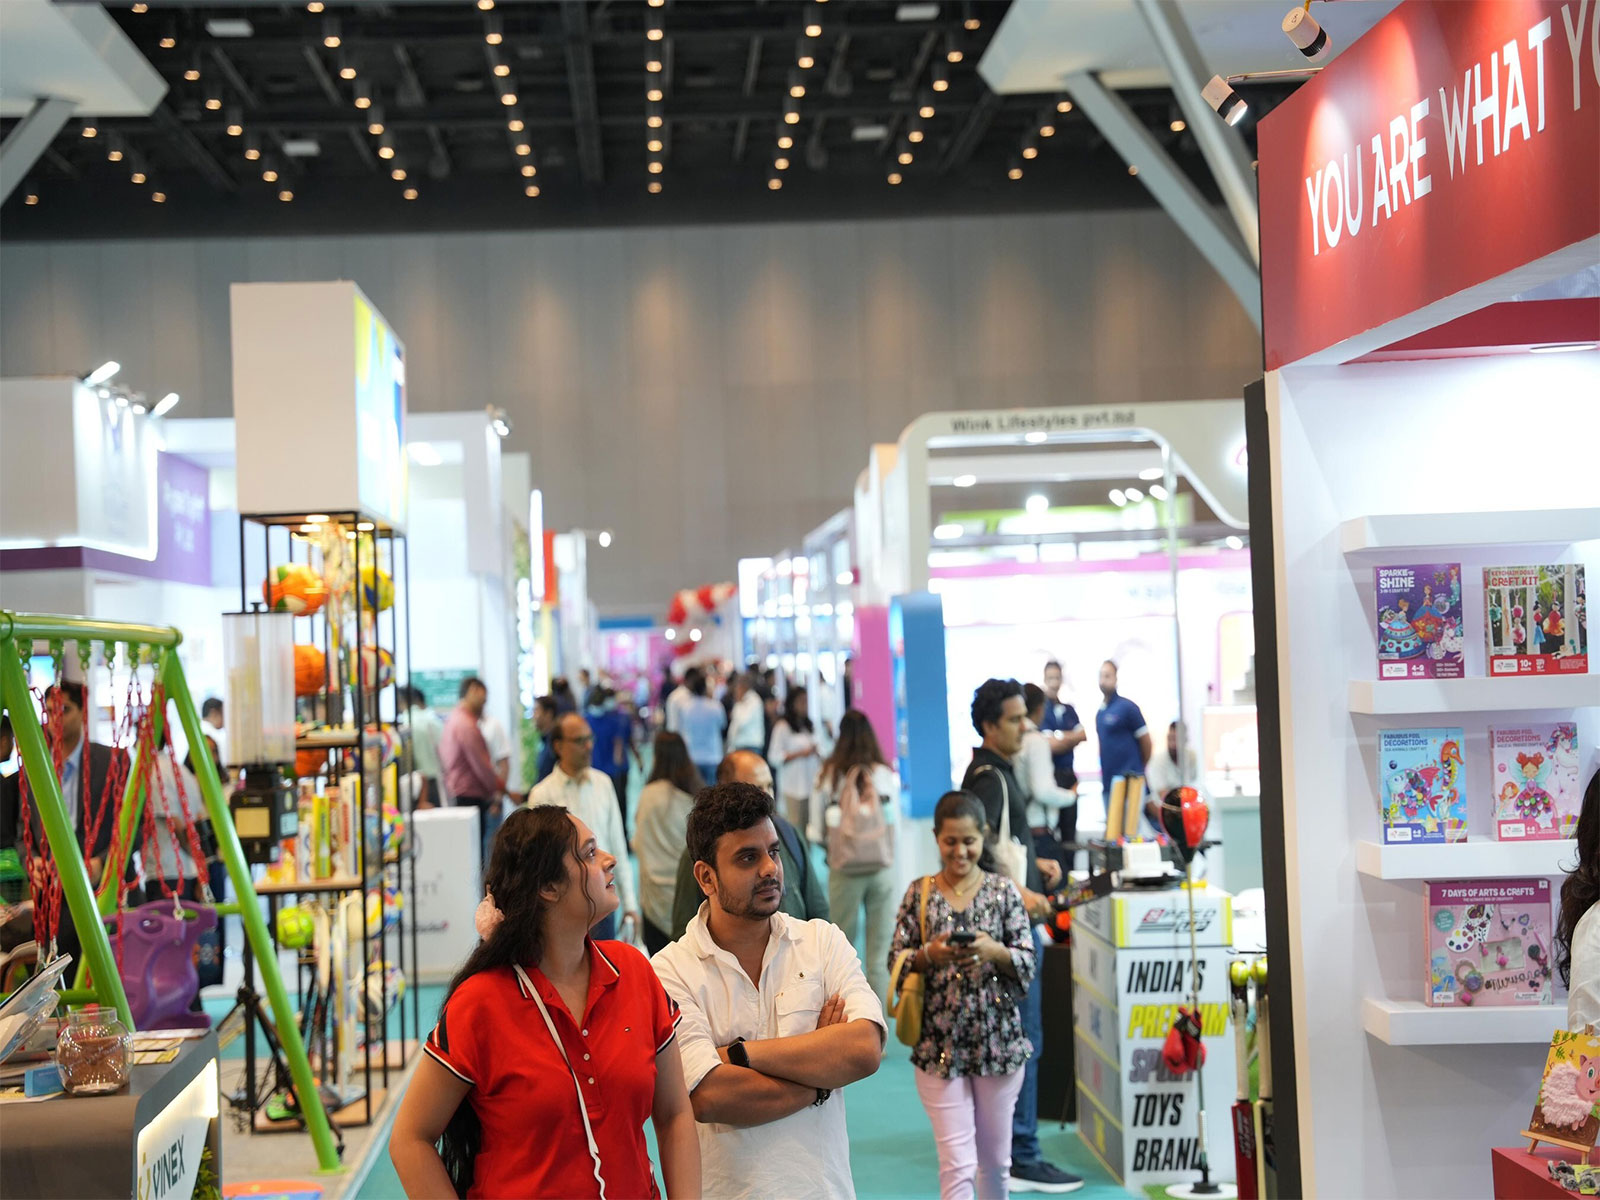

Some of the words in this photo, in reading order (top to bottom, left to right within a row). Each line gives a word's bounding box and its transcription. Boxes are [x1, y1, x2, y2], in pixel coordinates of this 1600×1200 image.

[1305, 144, 1363, 256] YOU
[1371, 97, 1432, 228] ARE
[1439, 16, 1551, 181] WHAT
[951, 415, 992, 433] Wink
[998, 413, 1077, 433] Lifestyles
[1380, 577, 1415, 589] SHINE
[1491, 577, 1520, 587] CRAFT
[1522, 575, 1538, 586] KIT
[1520, 659, 1532, 667] 10+
[1384, 738, 1428, 746] DECORATIONS
[1496, 735, 1541, 743] DECORATIONS
[1442, 889, 1447, 897] 7
[1447, 888, 1467, 898] DAYS
[1468, 889, 1478, 897] OF
[1479, 888, 1499, 897] ARTS
[1499, 888, 1506, 896] &
[1506, 887, 1535, 896] CRAFTS
[1126, 959, 1206, 993] INDIA'S
[1132, 1093, 1184, 1127] TOYS
[153, 1134, 185, 1200] VINEX
